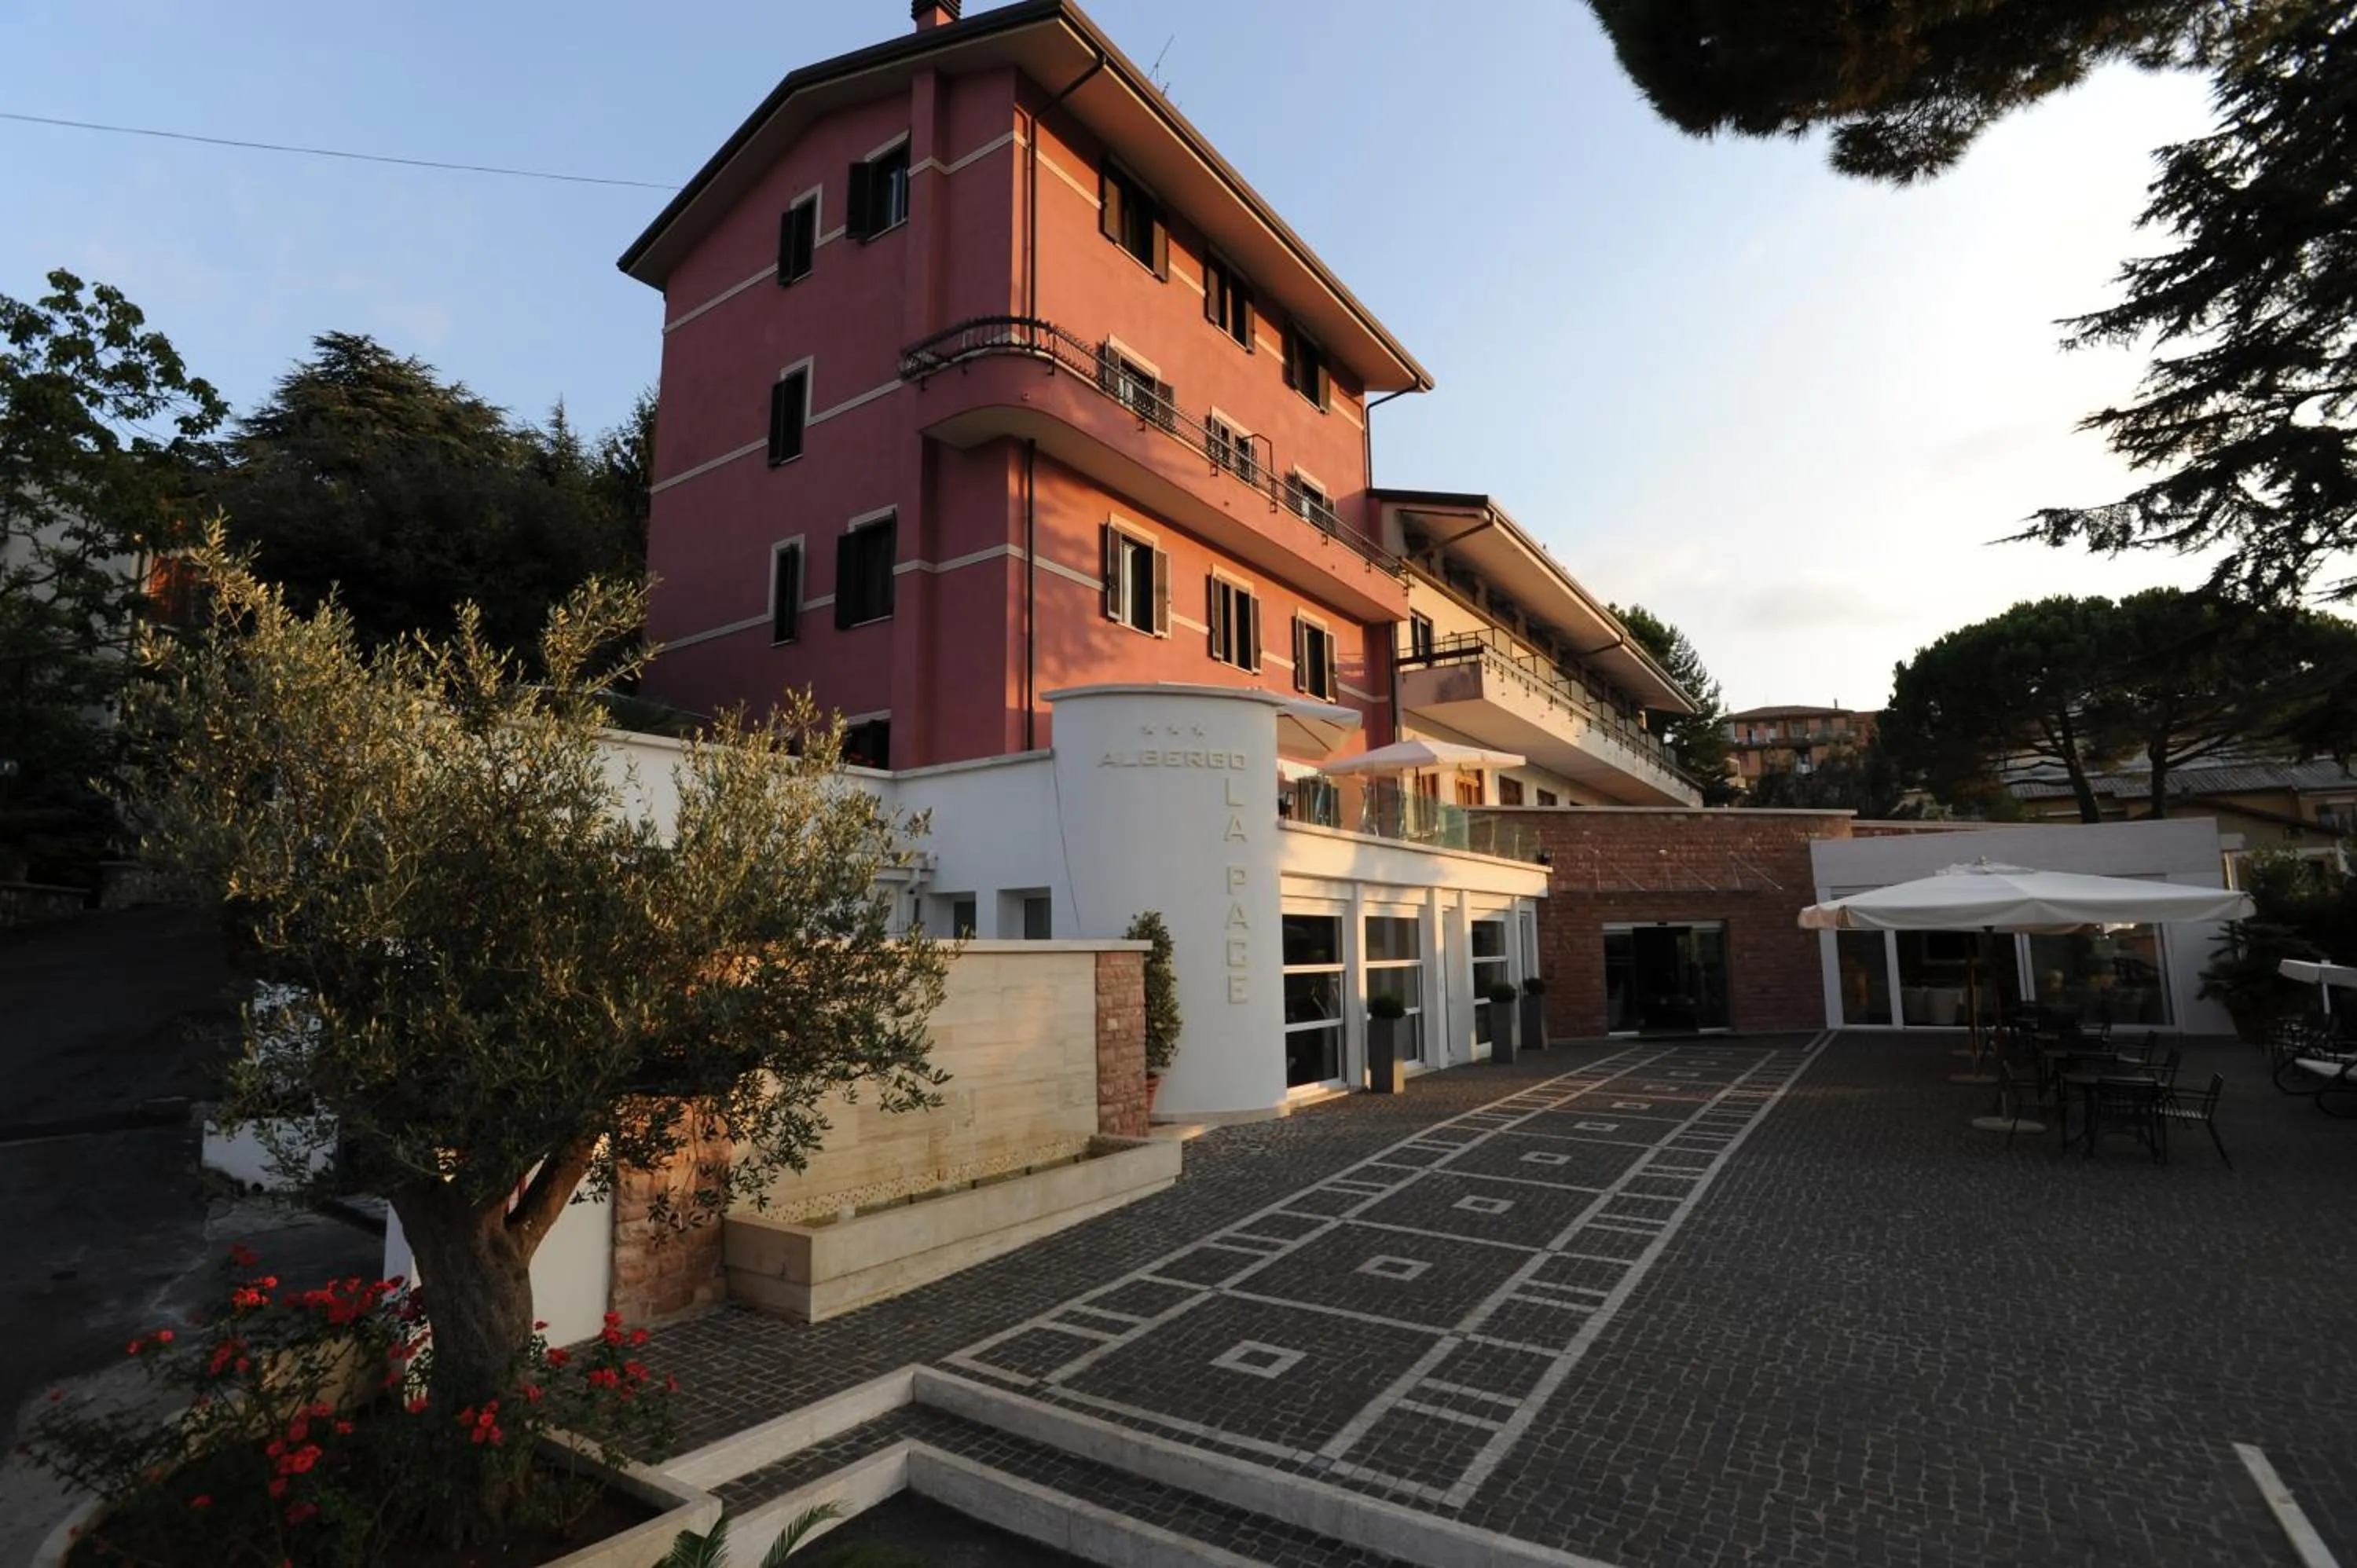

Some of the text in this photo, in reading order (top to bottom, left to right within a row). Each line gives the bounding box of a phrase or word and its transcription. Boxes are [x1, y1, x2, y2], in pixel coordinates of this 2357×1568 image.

[1098, 749, 1247, 770] ALBERGO
[1224, 777, 1249, 1005] LA PACE
